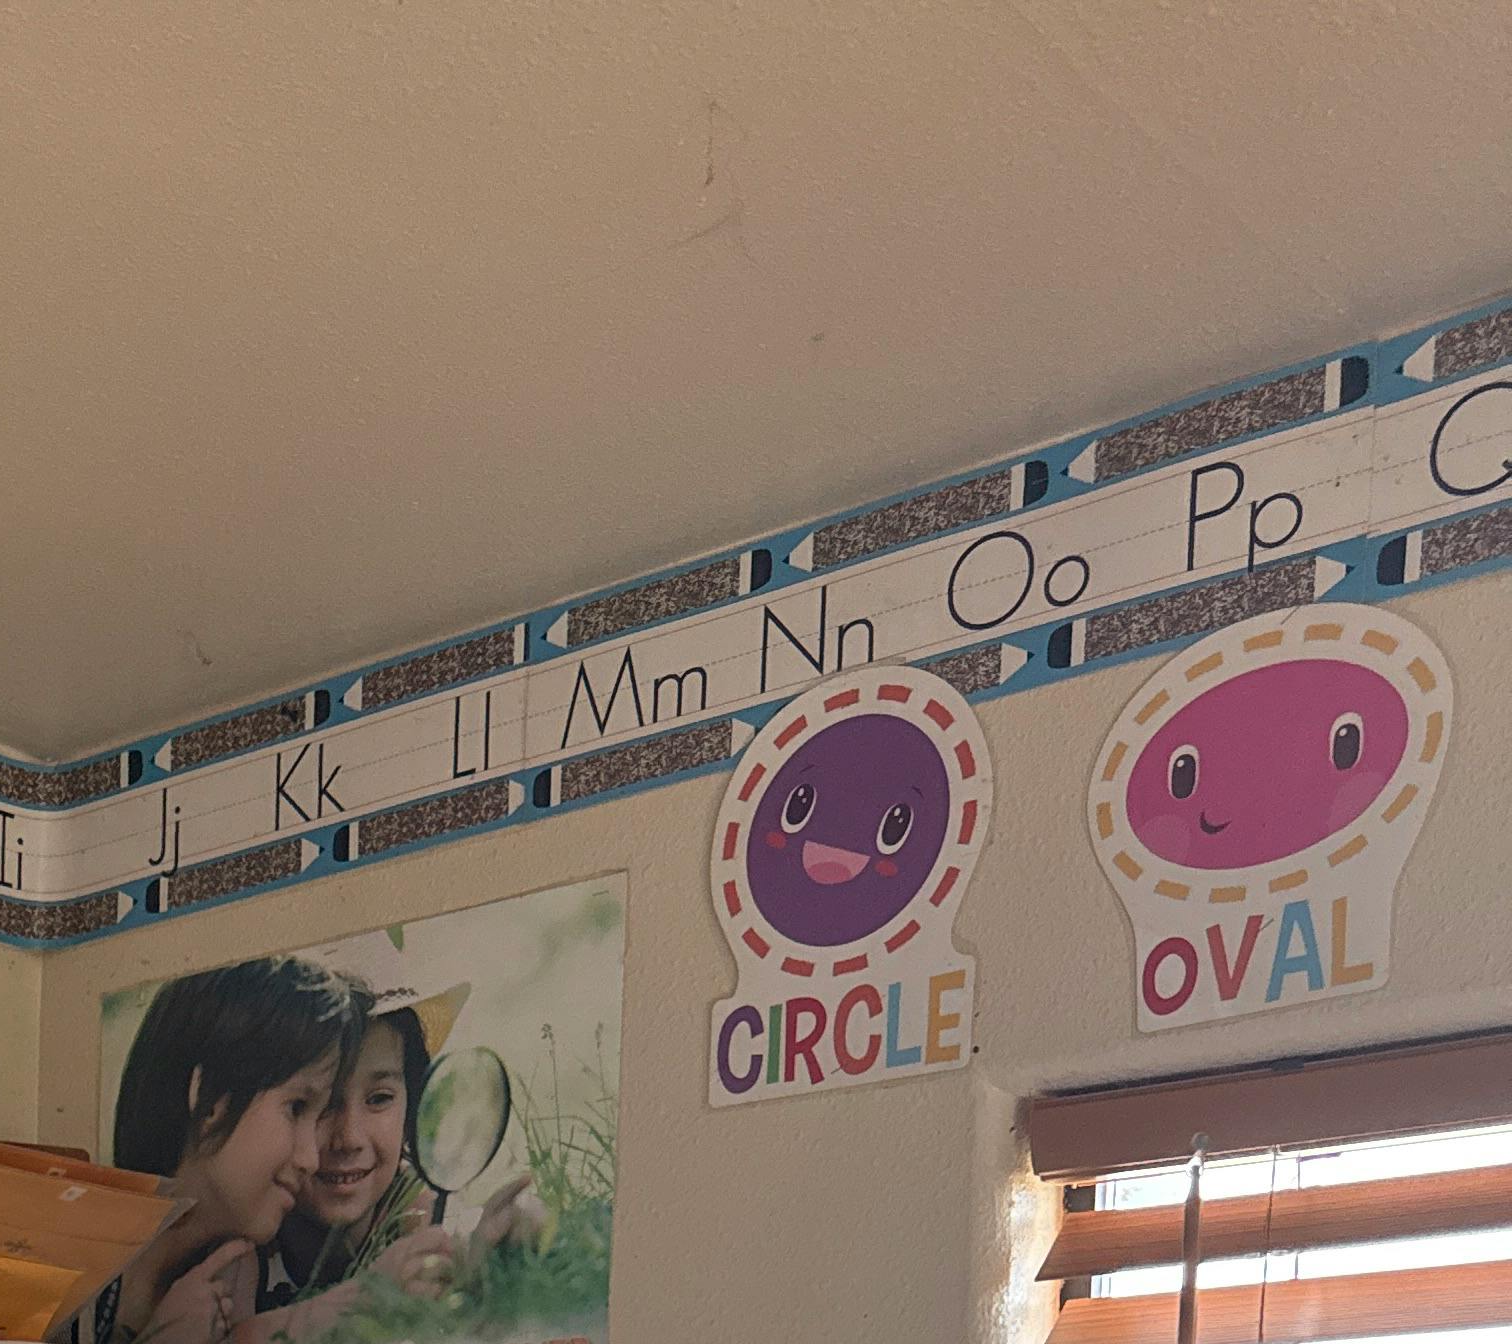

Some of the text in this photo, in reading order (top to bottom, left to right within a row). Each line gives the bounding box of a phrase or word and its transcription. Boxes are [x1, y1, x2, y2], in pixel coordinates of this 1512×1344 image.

[149, 788, 181, 877] Jj
[276, 742, 345, 831] Kk
[452, 691, 492, 779] Ll
[562, 646, 708, 750] Mm
[761, 585, 874, 692] Nn
[948, 531, 1090, 630] Oo
[1187, 462, 1303, 572] Pp
[1142, 899, 1374, 1016] OVAL
[717, 970, 965, 1094] CIRCLE
